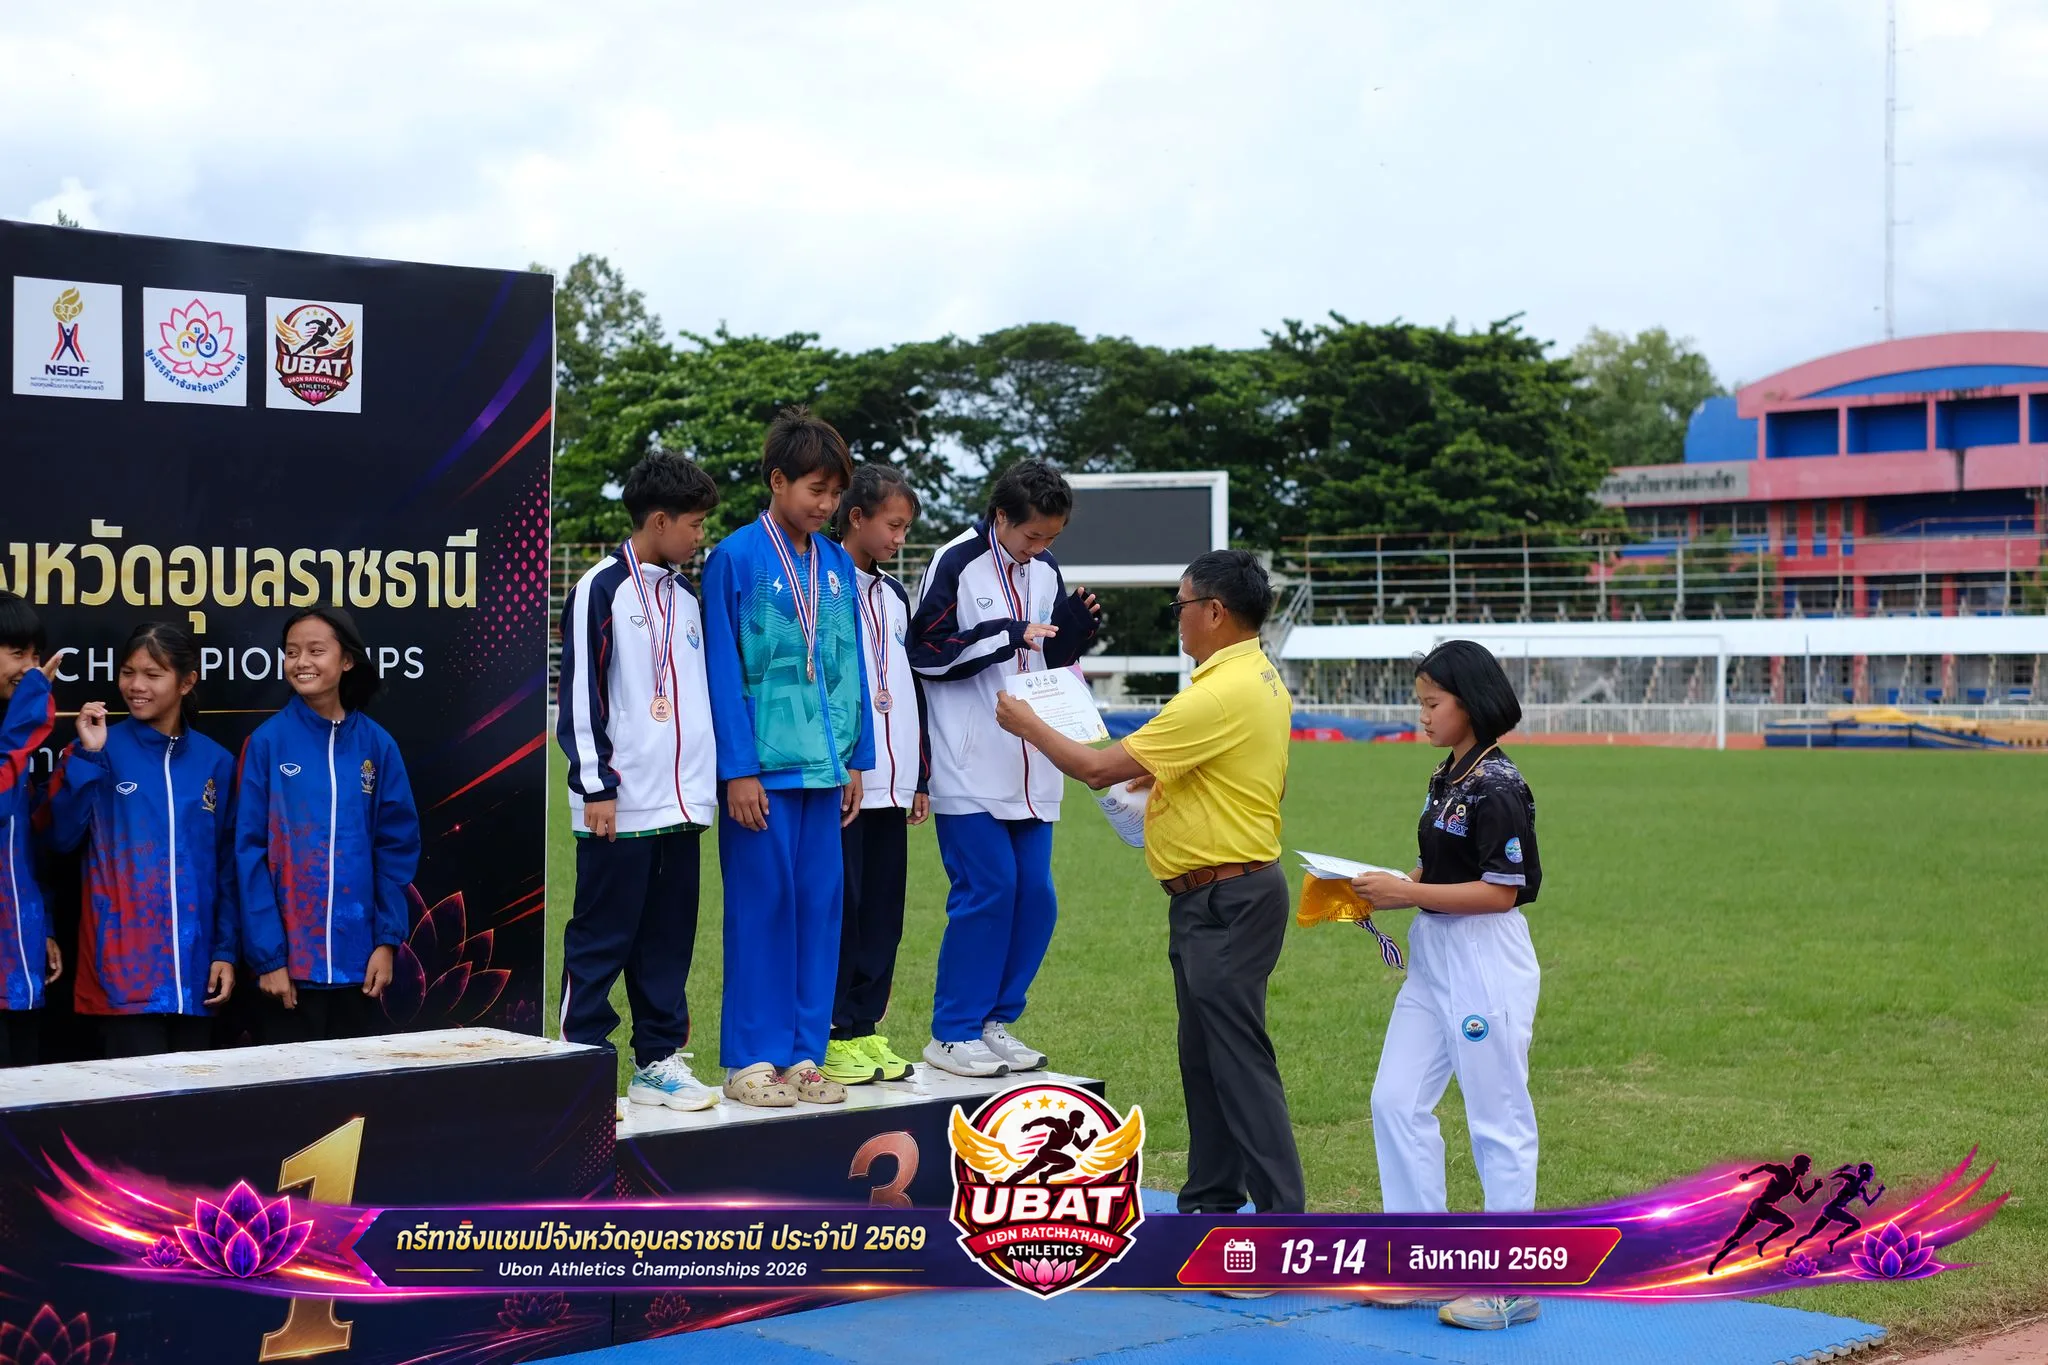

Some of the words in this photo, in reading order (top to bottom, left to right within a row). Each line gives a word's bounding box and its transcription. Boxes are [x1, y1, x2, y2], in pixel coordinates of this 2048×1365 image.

[45, 364, 90, 377] NSDF
[281, 354, 348, 378] UBAT
[298, 383, 331, 391] ATHLETICS
